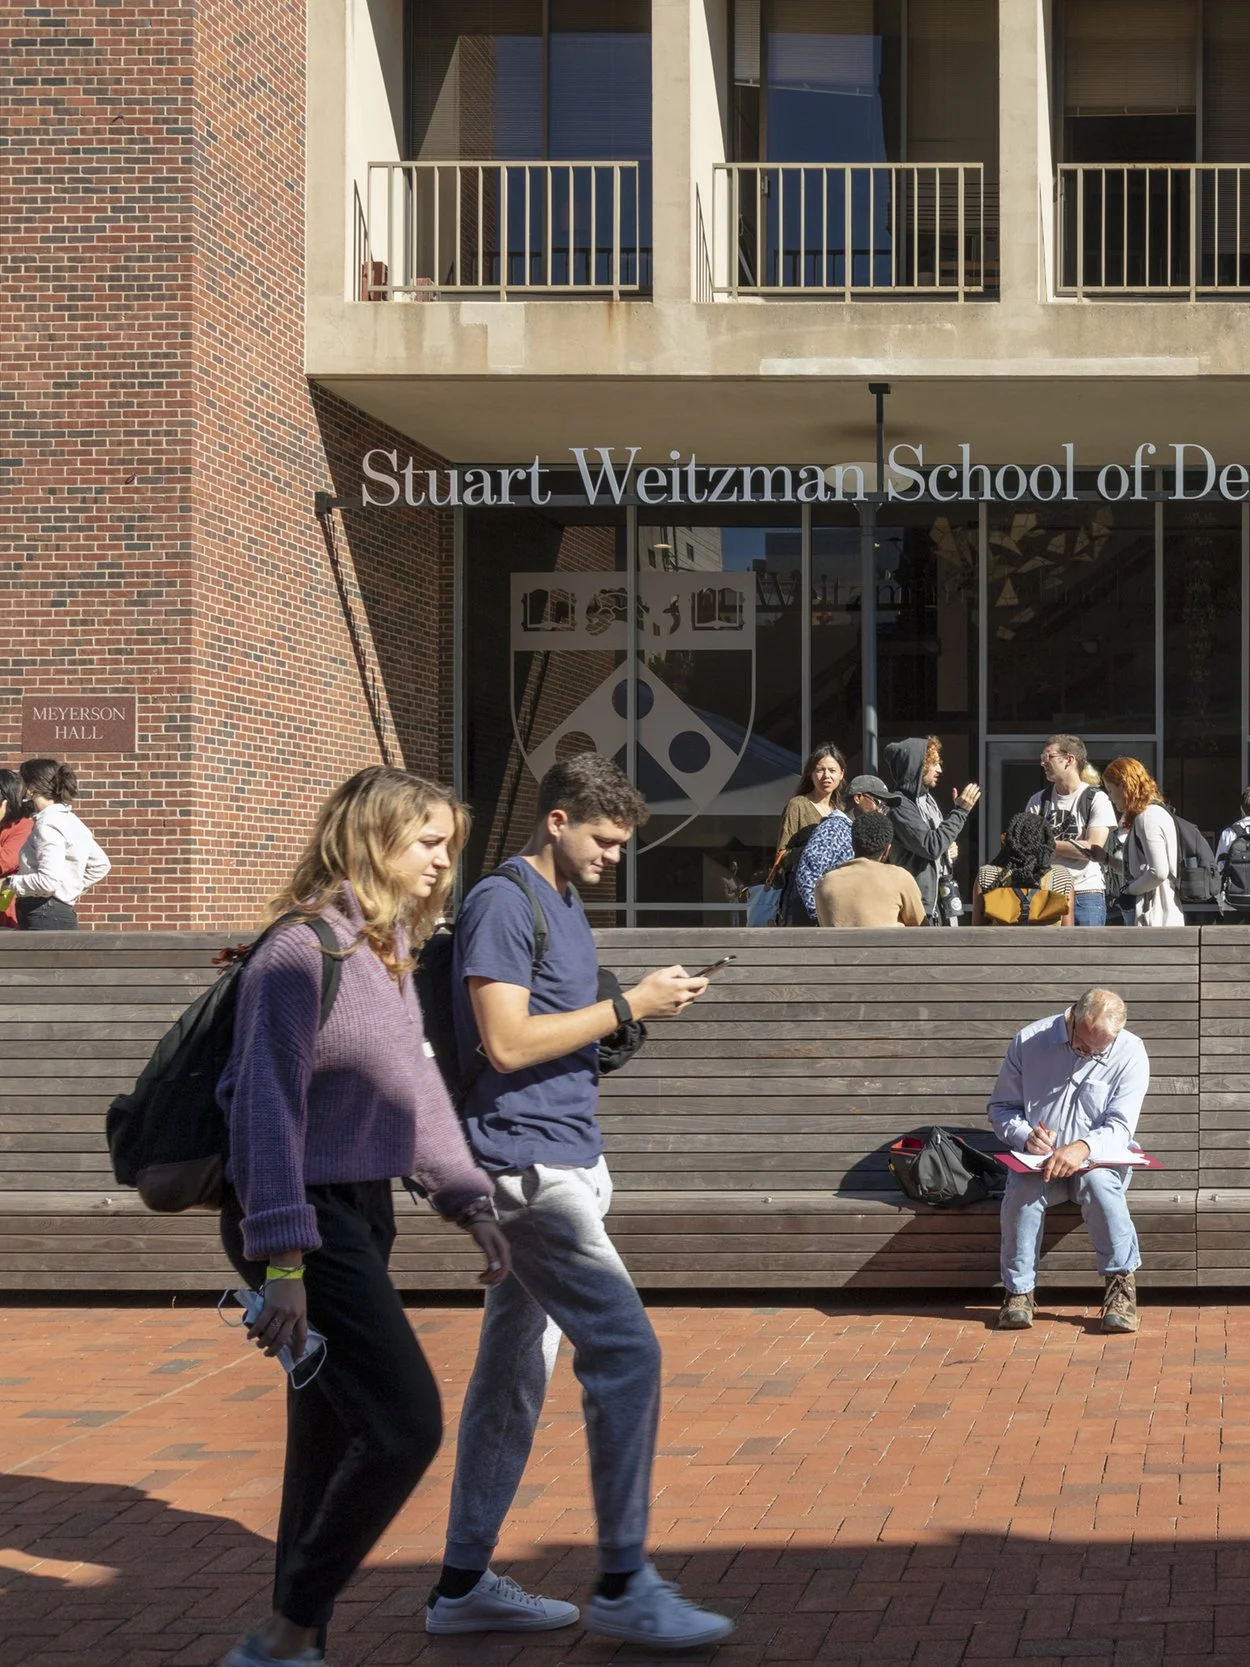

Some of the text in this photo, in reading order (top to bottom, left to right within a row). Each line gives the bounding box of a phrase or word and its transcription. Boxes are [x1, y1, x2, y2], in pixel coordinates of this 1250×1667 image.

[361, 448, 551, 507] Stuart
[568, 446, 869, 505] Weitzman
[887, 442, 1078, 502] School
[1096, 442, 1156, 501] of
[33, 707, 125, 721] MEYERSON
[55, 726, 104, 740] HALL
